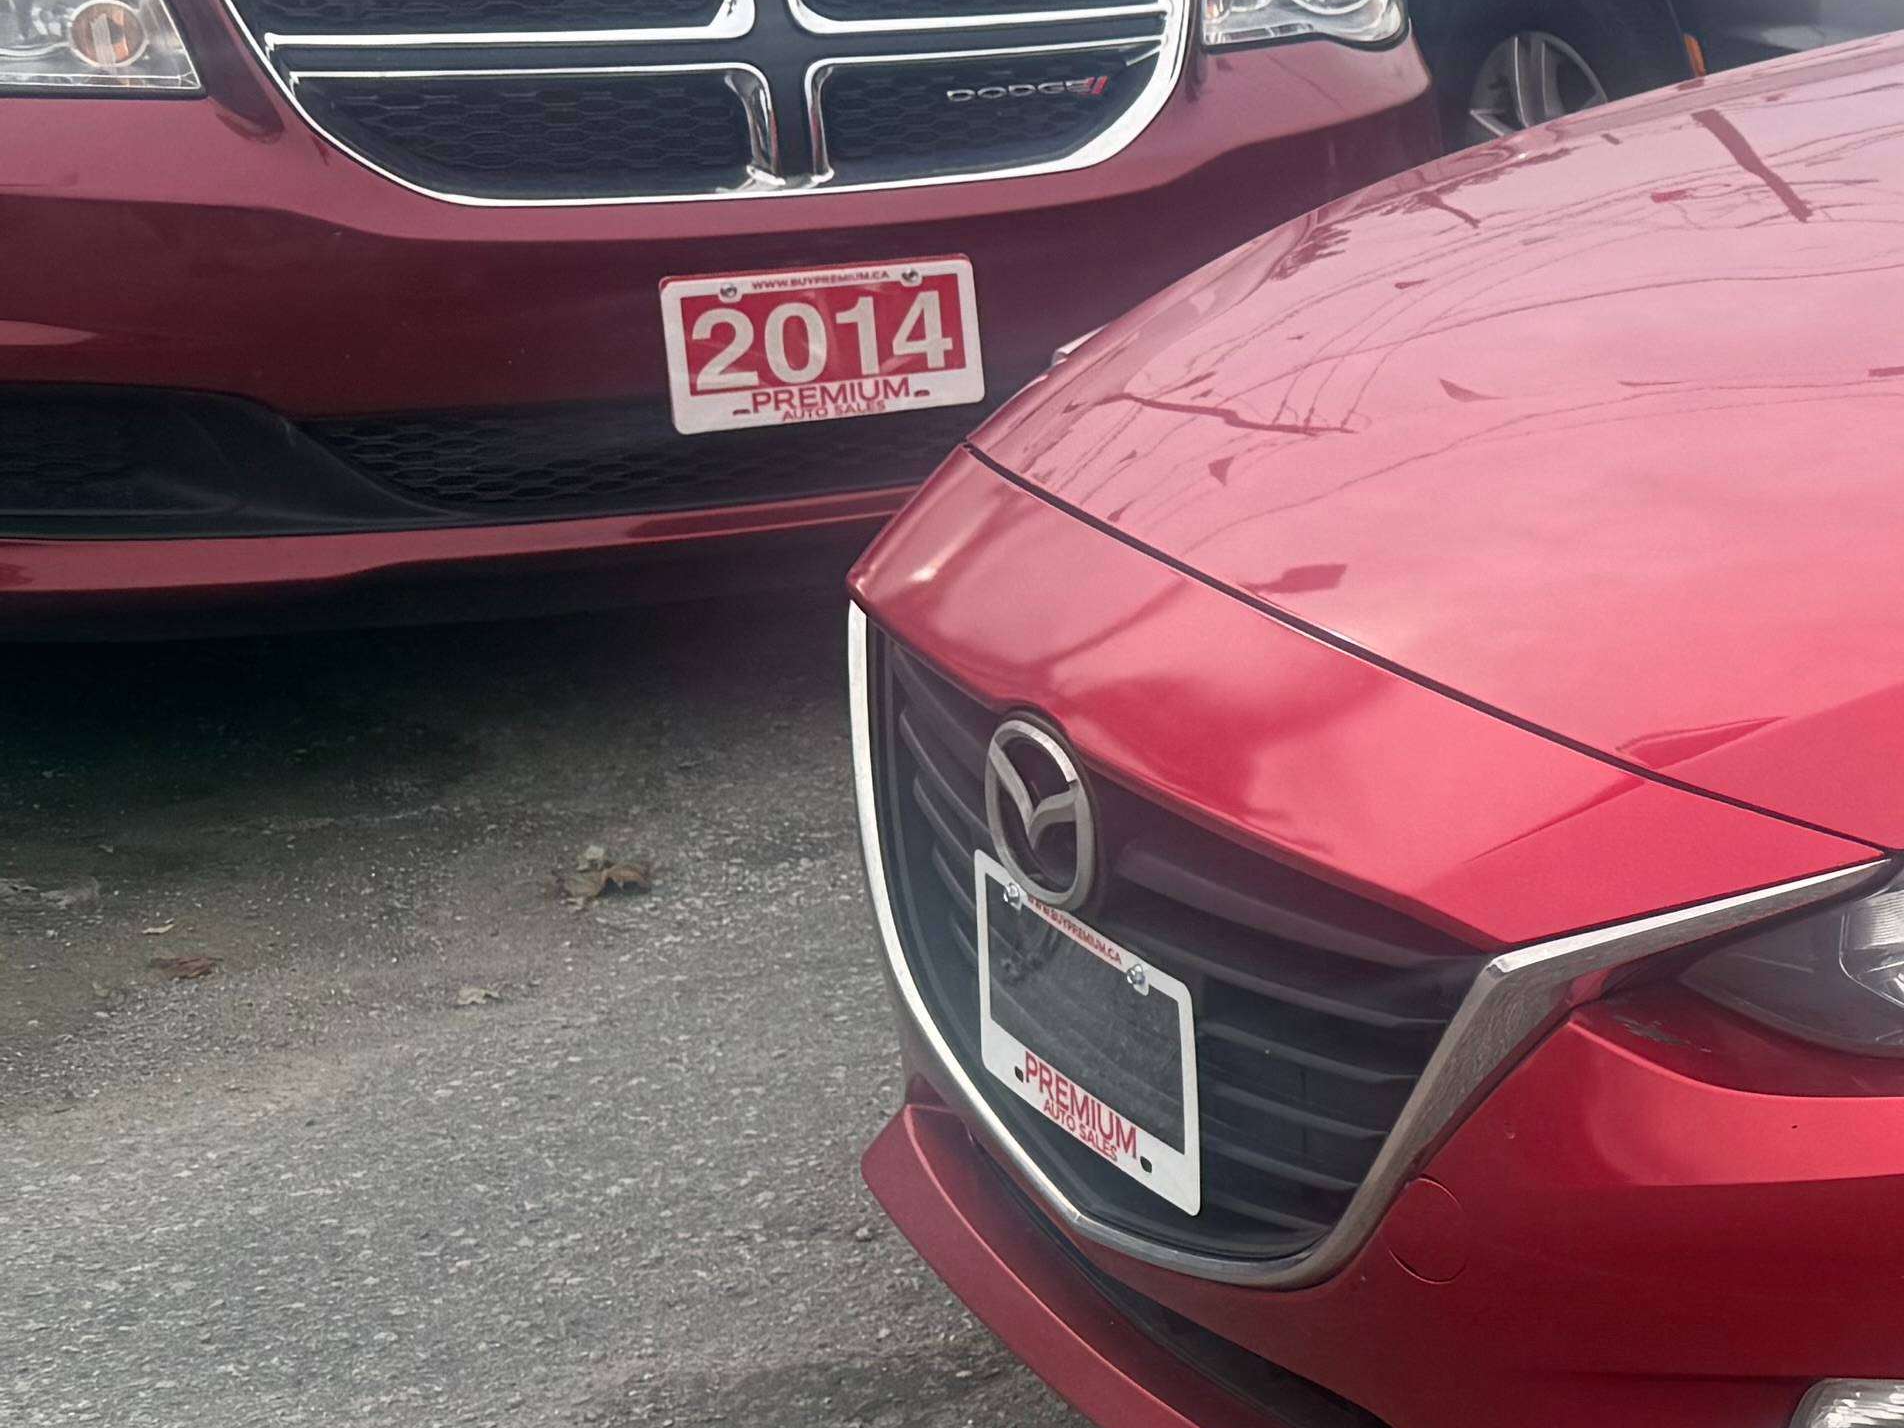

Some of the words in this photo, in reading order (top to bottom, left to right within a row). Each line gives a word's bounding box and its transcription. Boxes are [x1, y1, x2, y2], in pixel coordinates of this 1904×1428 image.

[946, 77, 1090, 103] DODGE
[751, 270, 891, 292] WWW.BUYPREMIUM.CA
[691, 290, 953, 392] 2014
[751, 376, 911, 414] PREMIUM
[782, 405, 828, 422] AUTO
[834, 400, 887, 416] SALES
[1025, 1050, 1138, 1160] PREMIUM
[1043, 1099, 1076, 1132] AUTO
[1079, 1123, 1118, 1163] SALES
